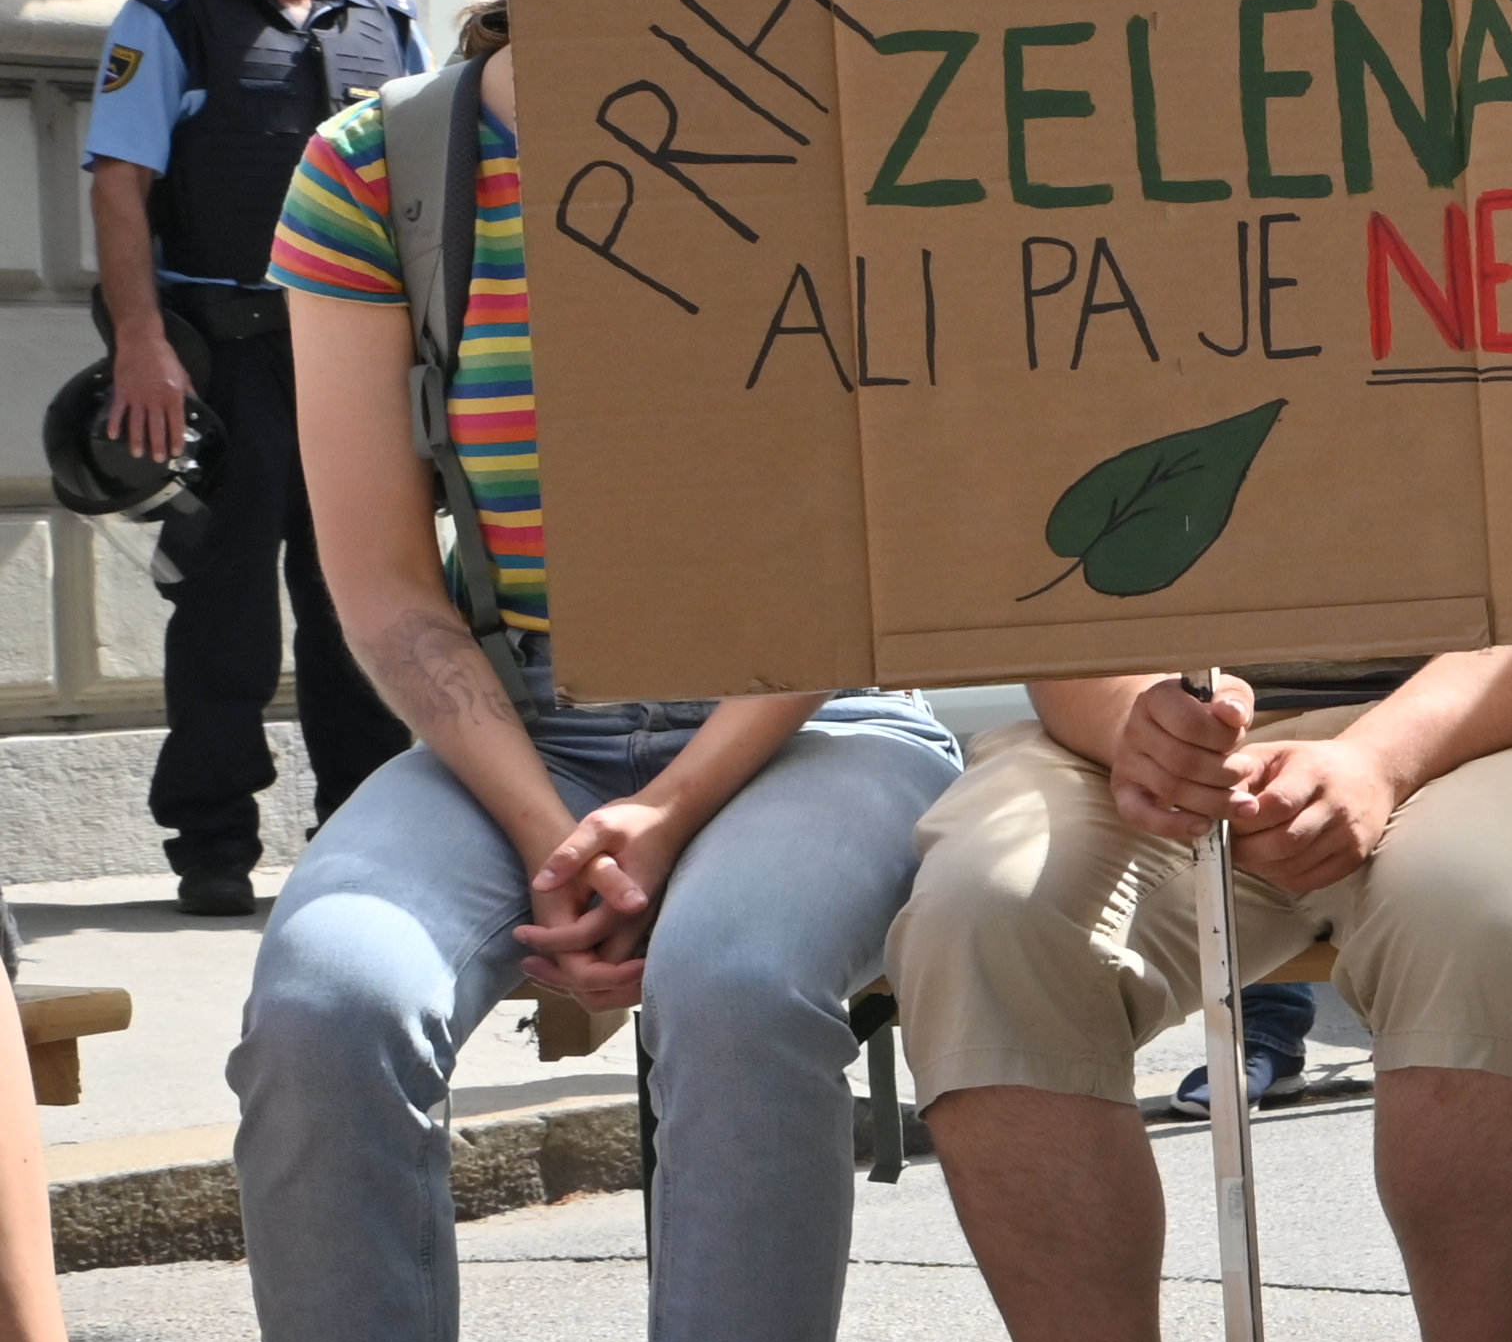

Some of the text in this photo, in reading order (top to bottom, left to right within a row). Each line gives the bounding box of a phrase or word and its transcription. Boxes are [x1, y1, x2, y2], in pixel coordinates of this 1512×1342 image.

[745, 249, 937, 391] ALI
[1023, 236, 1159, 371] PA
[1200, 213, 1322, 359] JE
